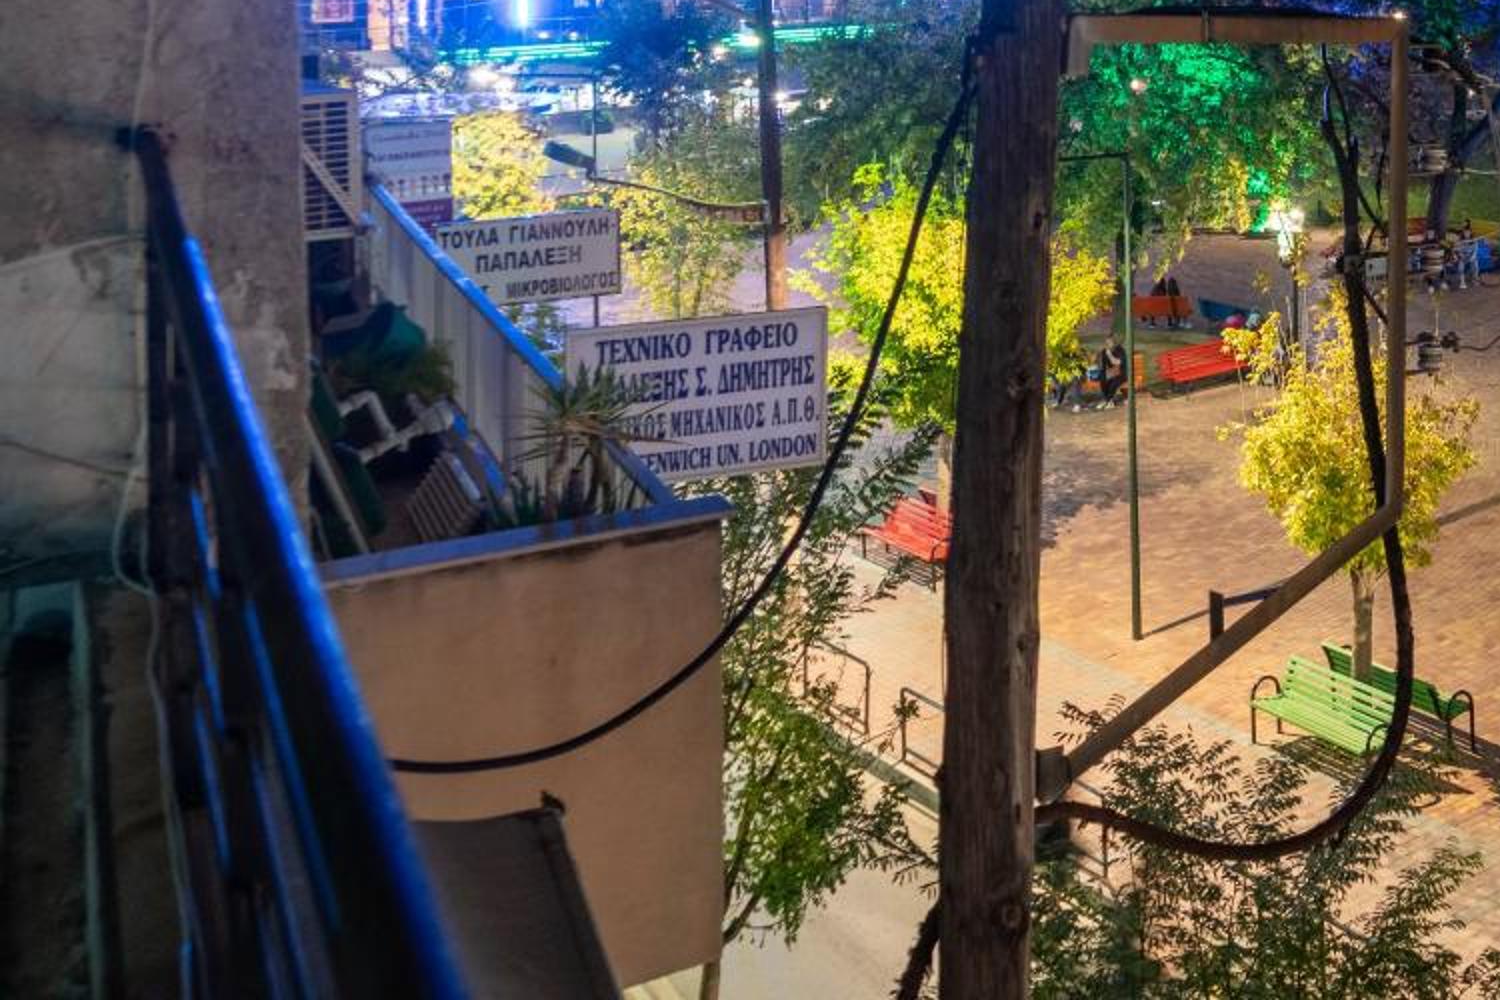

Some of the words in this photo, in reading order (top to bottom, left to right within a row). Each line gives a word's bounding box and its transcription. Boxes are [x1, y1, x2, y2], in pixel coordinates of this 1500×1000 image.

[438, 228, 499, 250] ΤΟΥΛΑ
[475, 244, 583, 274] ΠΑΠΑΛΕΞΗ
[505, 270, 617, 299] ΜΙΚΡΟΒΙΟΛΟΓΟΣ
[596, 331, 692, 366] ΤΕΧΝΙΚΟ
[705, 321, 798, 356] ΓΡΑΦΕΙΟ
[694, 366, 713, 397] Σ.
[717, 354, 816, 395] ΔΗΜΗΤΡΗΣ
[670, 401, 766, 439] ΜΗΧΑΝΙΚΟΣ
[640, 446, 711, 473] ENWICH
[717, 442, 743, 467] UN.
[748, 433, 817, 462] LONDON
